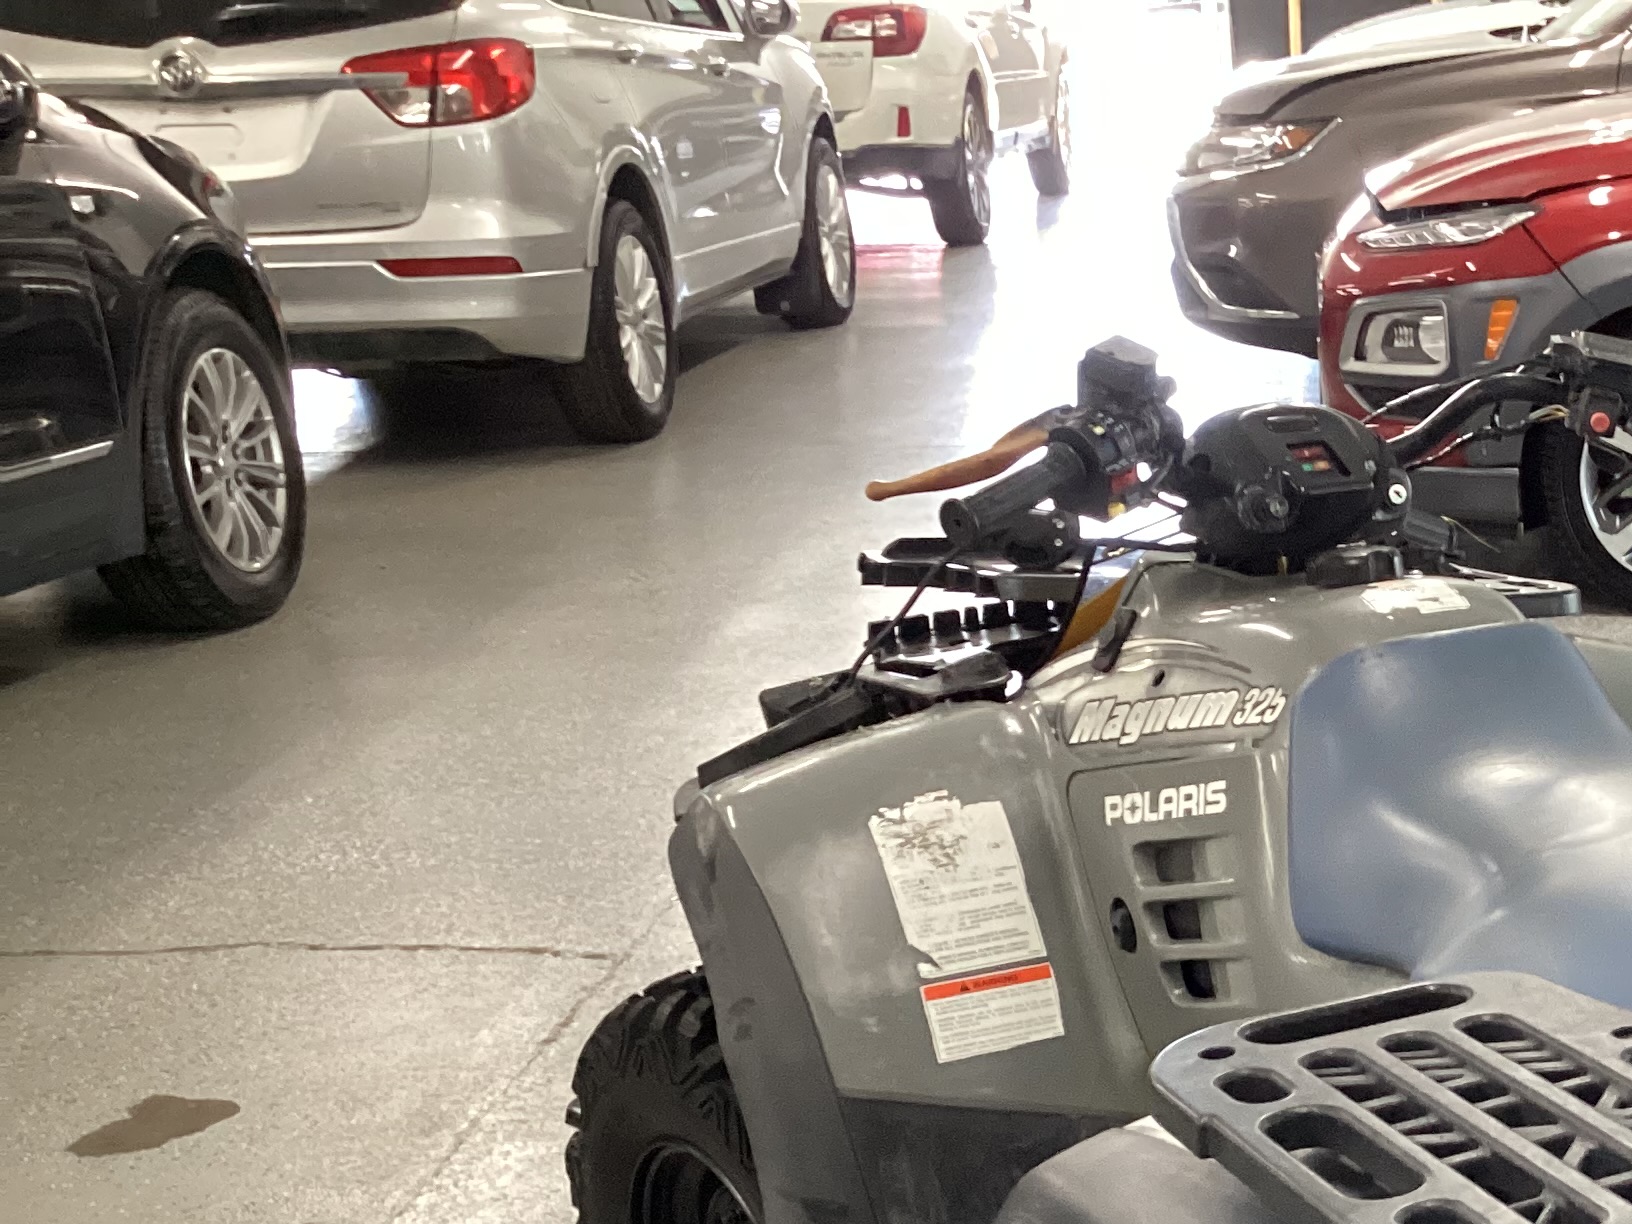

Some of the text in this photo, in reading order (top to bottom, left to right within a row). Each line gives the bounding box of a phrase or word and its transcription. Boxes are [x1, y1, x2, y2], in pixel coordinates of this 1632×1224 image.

[1068, 686, 1287, 746] Magnum 325
[1104, 780, 1228, 827] POLARIS
